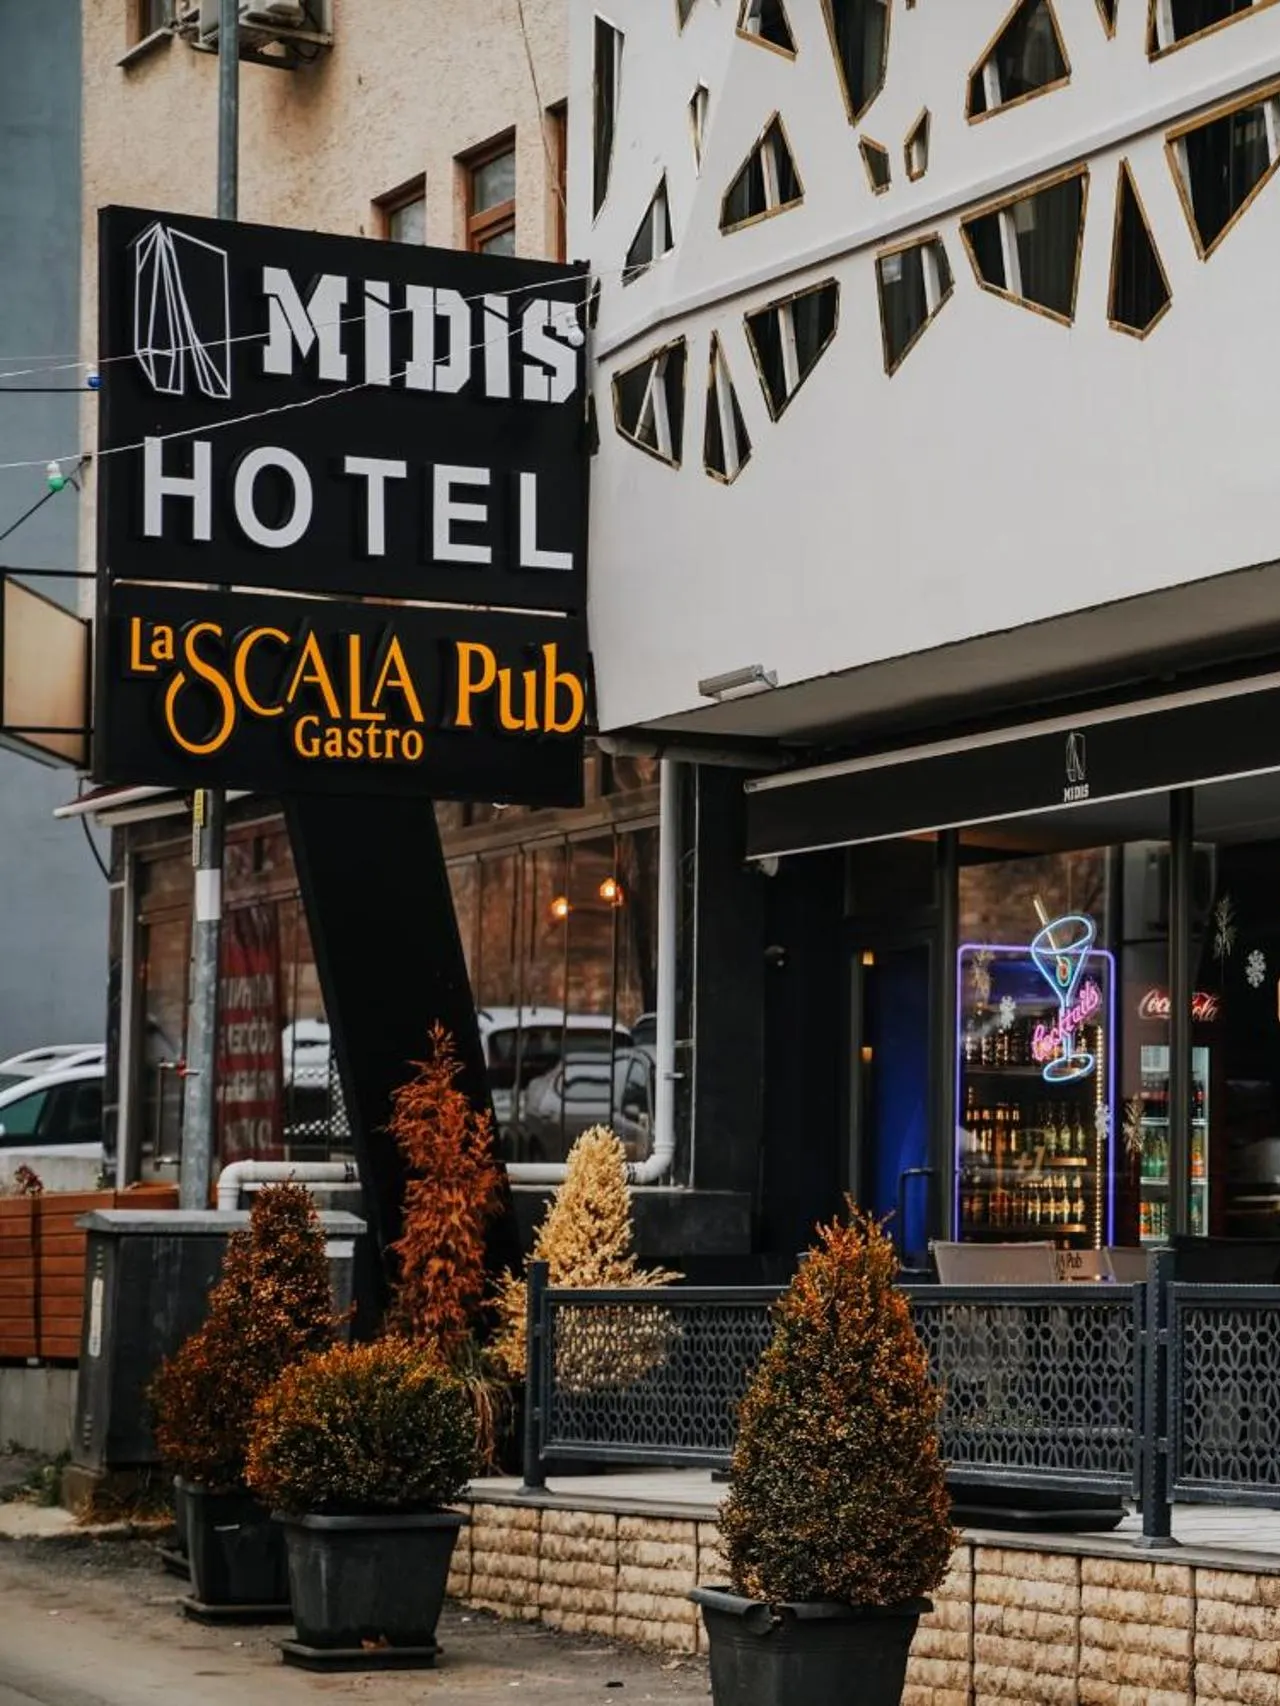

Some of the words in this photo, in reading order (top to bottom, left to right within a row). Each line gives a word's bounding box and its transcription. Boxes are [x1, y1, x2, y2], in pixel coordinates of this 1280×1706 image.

[143, 435, 575, 571] HOTEL
[130, 616, 175, 672] La
[164, 622, 424, 755] SCALA
[455, 641, 585, 734] Pub
[294, 715, 425, 760] Gastro
[1063, 783, 1090, 803] MIDIS
